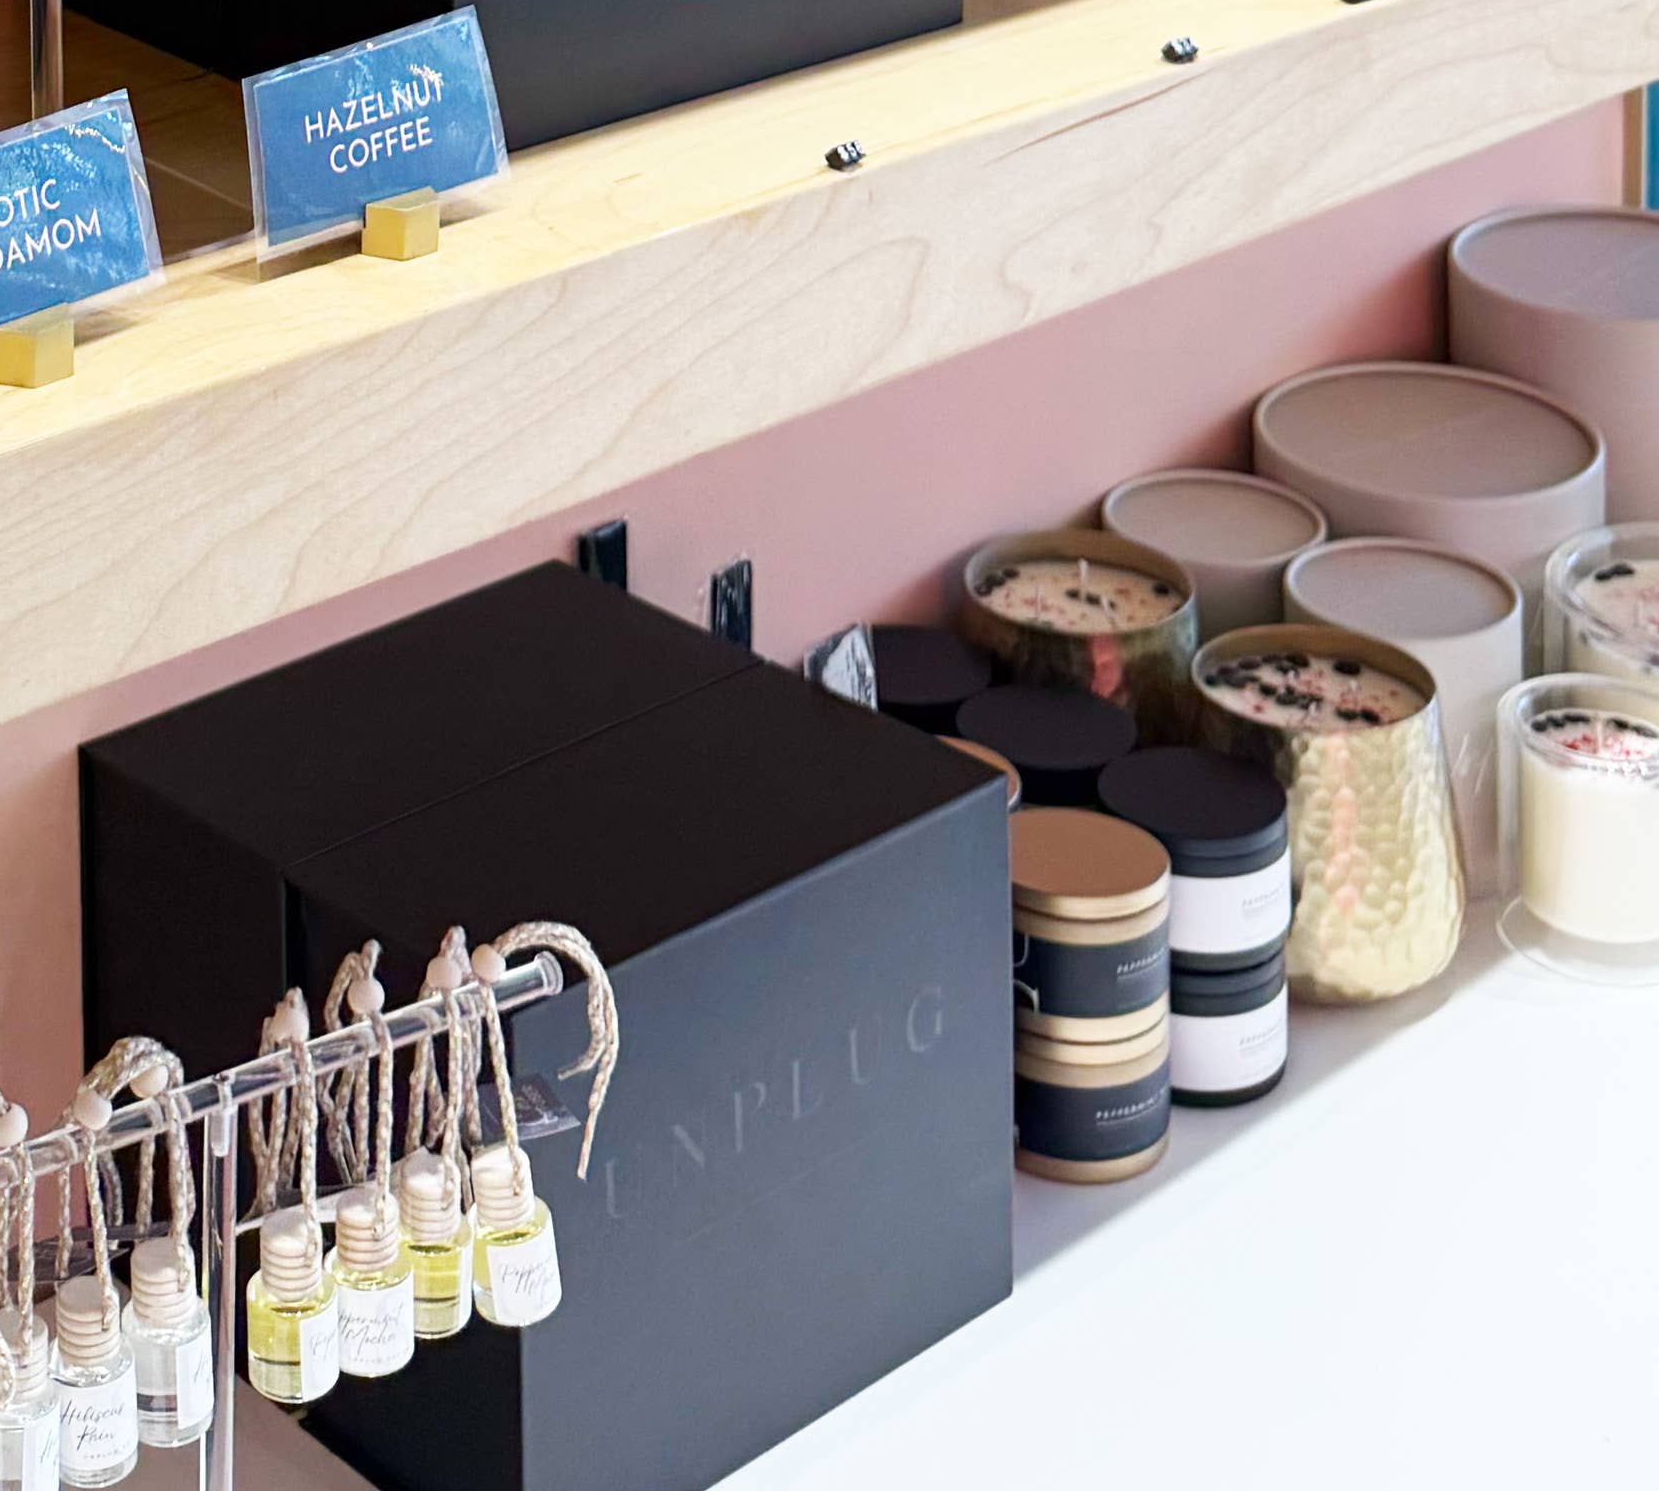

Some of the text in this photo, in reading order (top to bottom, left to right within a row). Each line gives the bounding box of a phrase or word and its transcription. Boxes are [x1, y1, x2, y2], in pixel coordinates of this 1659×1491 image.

[303, 72, 444, 144] HAZELNUT
[328, 116, 433, 174] COFFEE
[604, 985, 943, 1219] UNPLUG
